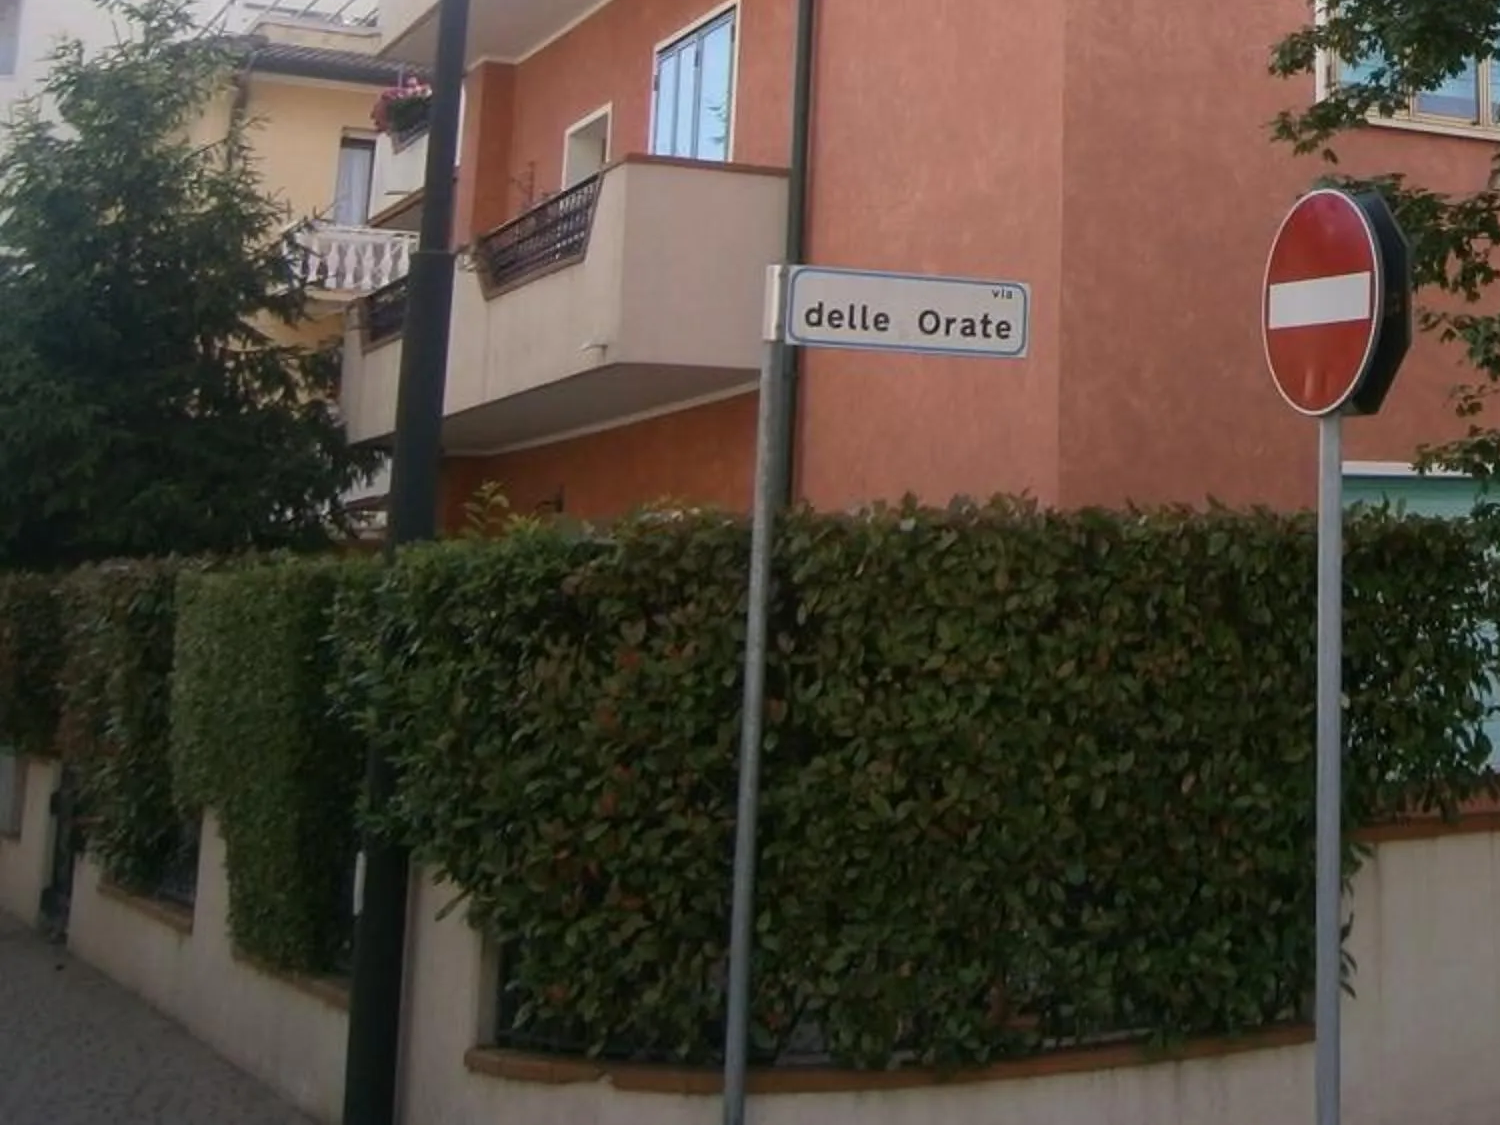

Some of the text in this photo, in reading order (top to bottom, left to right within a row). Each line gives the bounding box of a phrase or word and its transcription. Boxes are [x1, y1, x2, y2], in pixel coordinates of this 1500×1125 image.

[991, 287, 1013, 300] via
[804, 301, 1013, 340] delle Orate
